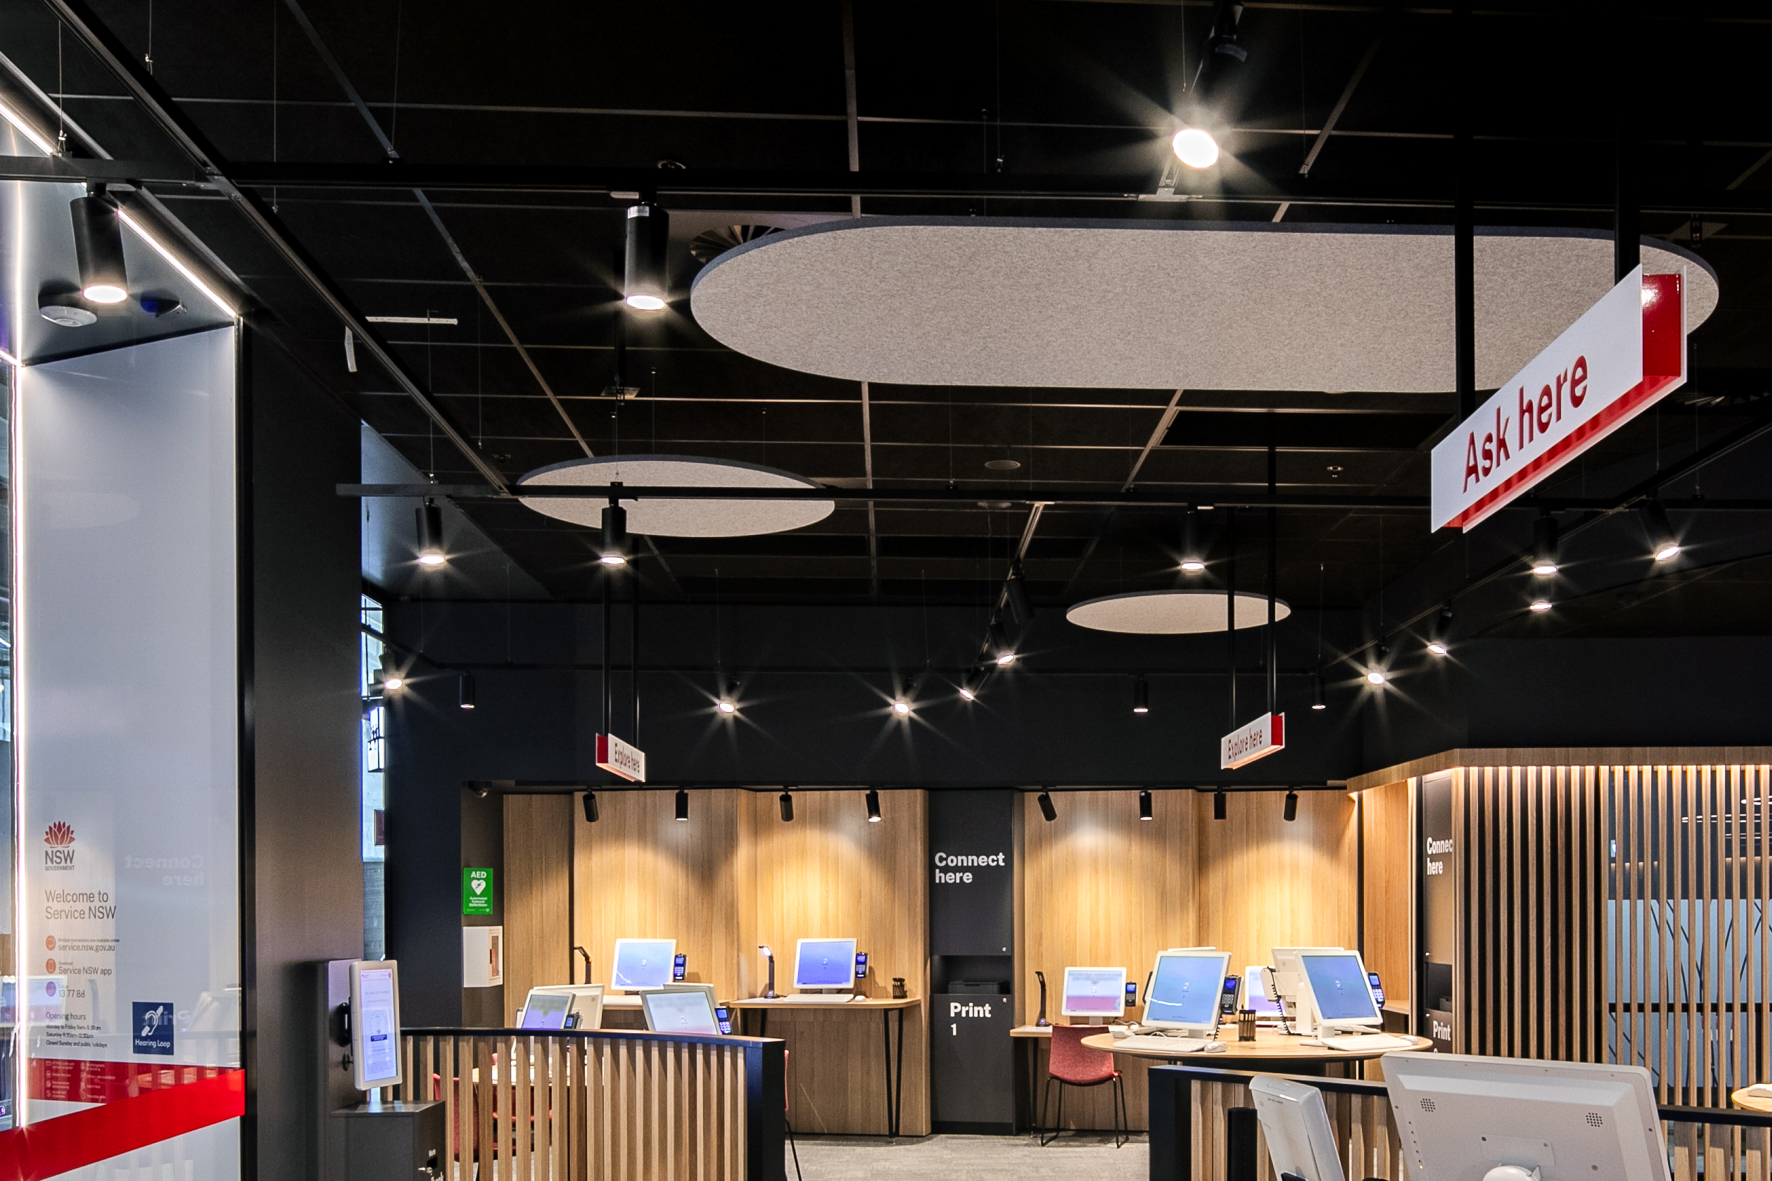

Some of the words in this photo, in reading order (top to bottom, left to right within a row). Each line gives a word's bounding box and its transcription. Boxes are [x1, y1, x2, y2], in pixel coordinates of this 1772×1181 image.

[1463, 406, 1510, 493] Ask
[1518, 355, 1588, 451] here
[1228, 739, 1248, 761] Explore
[1249, 728, 1262, 749] here
[615, 743, 630, 769] Explore
[631, 751, 639, 773] here
[1427, 837, 1453, 854] Connec
[45, 850, 75, 865] NSW
[934, 852, 1005, 866] Connect
[1427, 857, 1443, 875] here
[935, 869, 973, 883] here
[45, 889, 95, 903] Welcome
[98, 890, 109, 903] to
[45, 906, 85, 919] Service
[88, 905, 117, 919] NSW
[58, 943, 116, 953] service.nsw.gov.au
[58, 966, 82, 975] Service
[83, 966, 99, 975] NSW
[100, 968, 113, 976] app
[46, 1011, 69, 1021] Opening
[70, 1012, 86, 1020] hours
[950, 1002, 991, 1018] Print
[950, 1023, 957, 1036] 1
[1433, 1020, 1451, 1041] Print
[135, 1039, 156, 1048] Hearing
[157, 1040, 171, 1048] Loop
